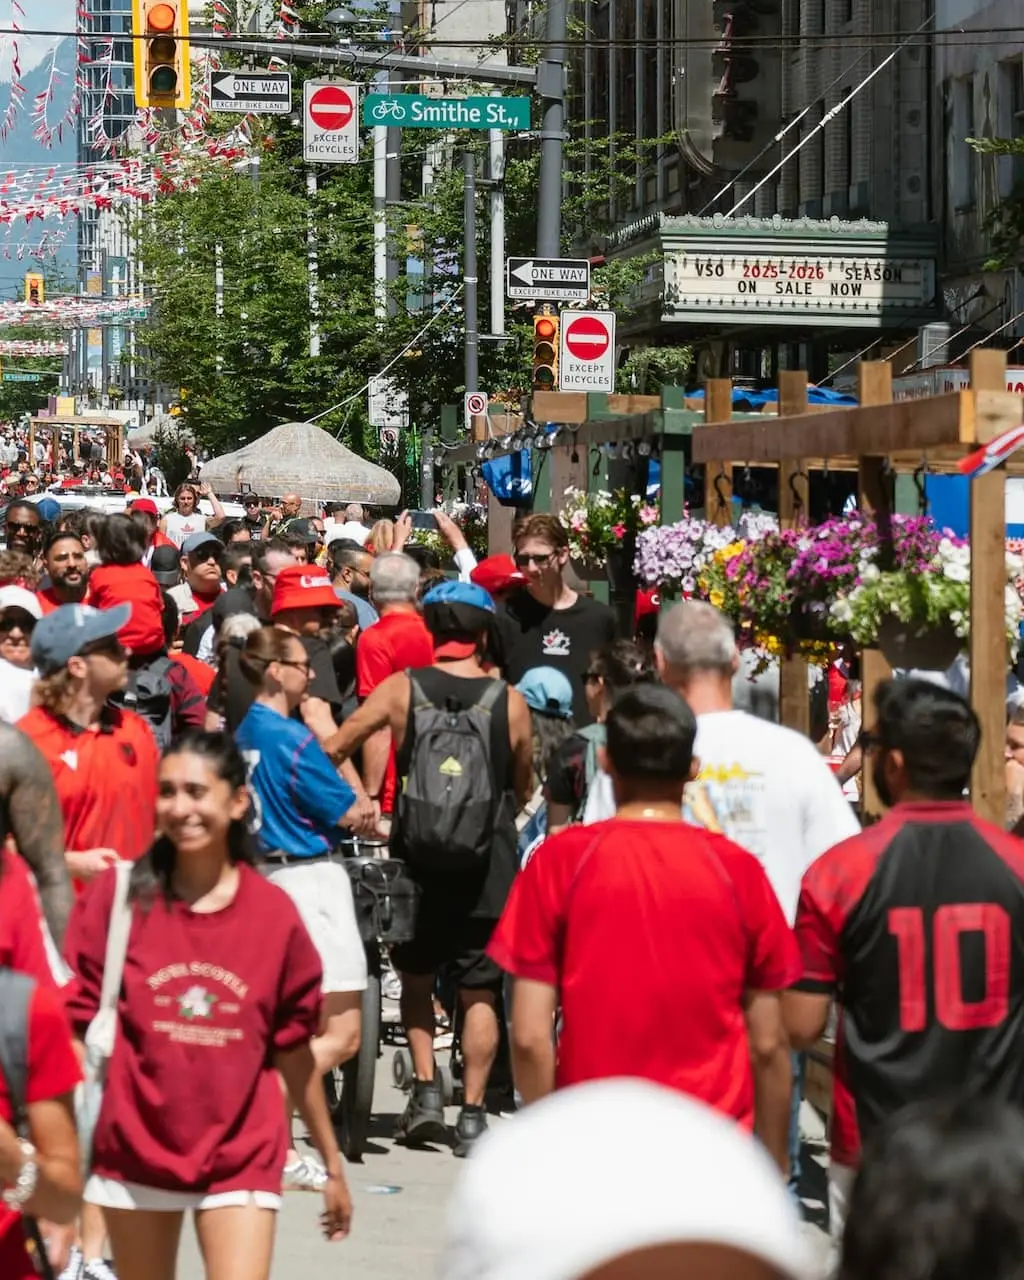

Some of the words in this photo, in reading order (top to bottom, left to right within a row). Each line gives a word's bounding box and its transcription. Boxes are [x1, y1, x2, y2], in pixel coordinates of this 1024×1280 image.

[233, 81, 256, 92] ONE
[261, 82, 285, 93] WAY
[216, 101, 242, 109] EXCEPT
[265, 102, 284, 110] LANE
[411, 101, 481, 122] Smithe
[313, 134, 349, 143] EXCEPT
[309, 145, 354, 154] BICYCLES
[531, 269, 554, 280] ONE
[560, 269, 584, 280] WAY
[695, 263, 724, 277] VSO
[743, 265, 824, 280] 2025-2026
[845, 268, 902, 281] SEASON
[738, 280, 757, 293] ON
[775, 282, 812, 295] SALE
[830, 283, 862, 296] NOW
[569, 364, 605, 372] EXCEPT
[565, 375, 609, 385] BICYCLES
[888, 902, 1011, 1033] 10
